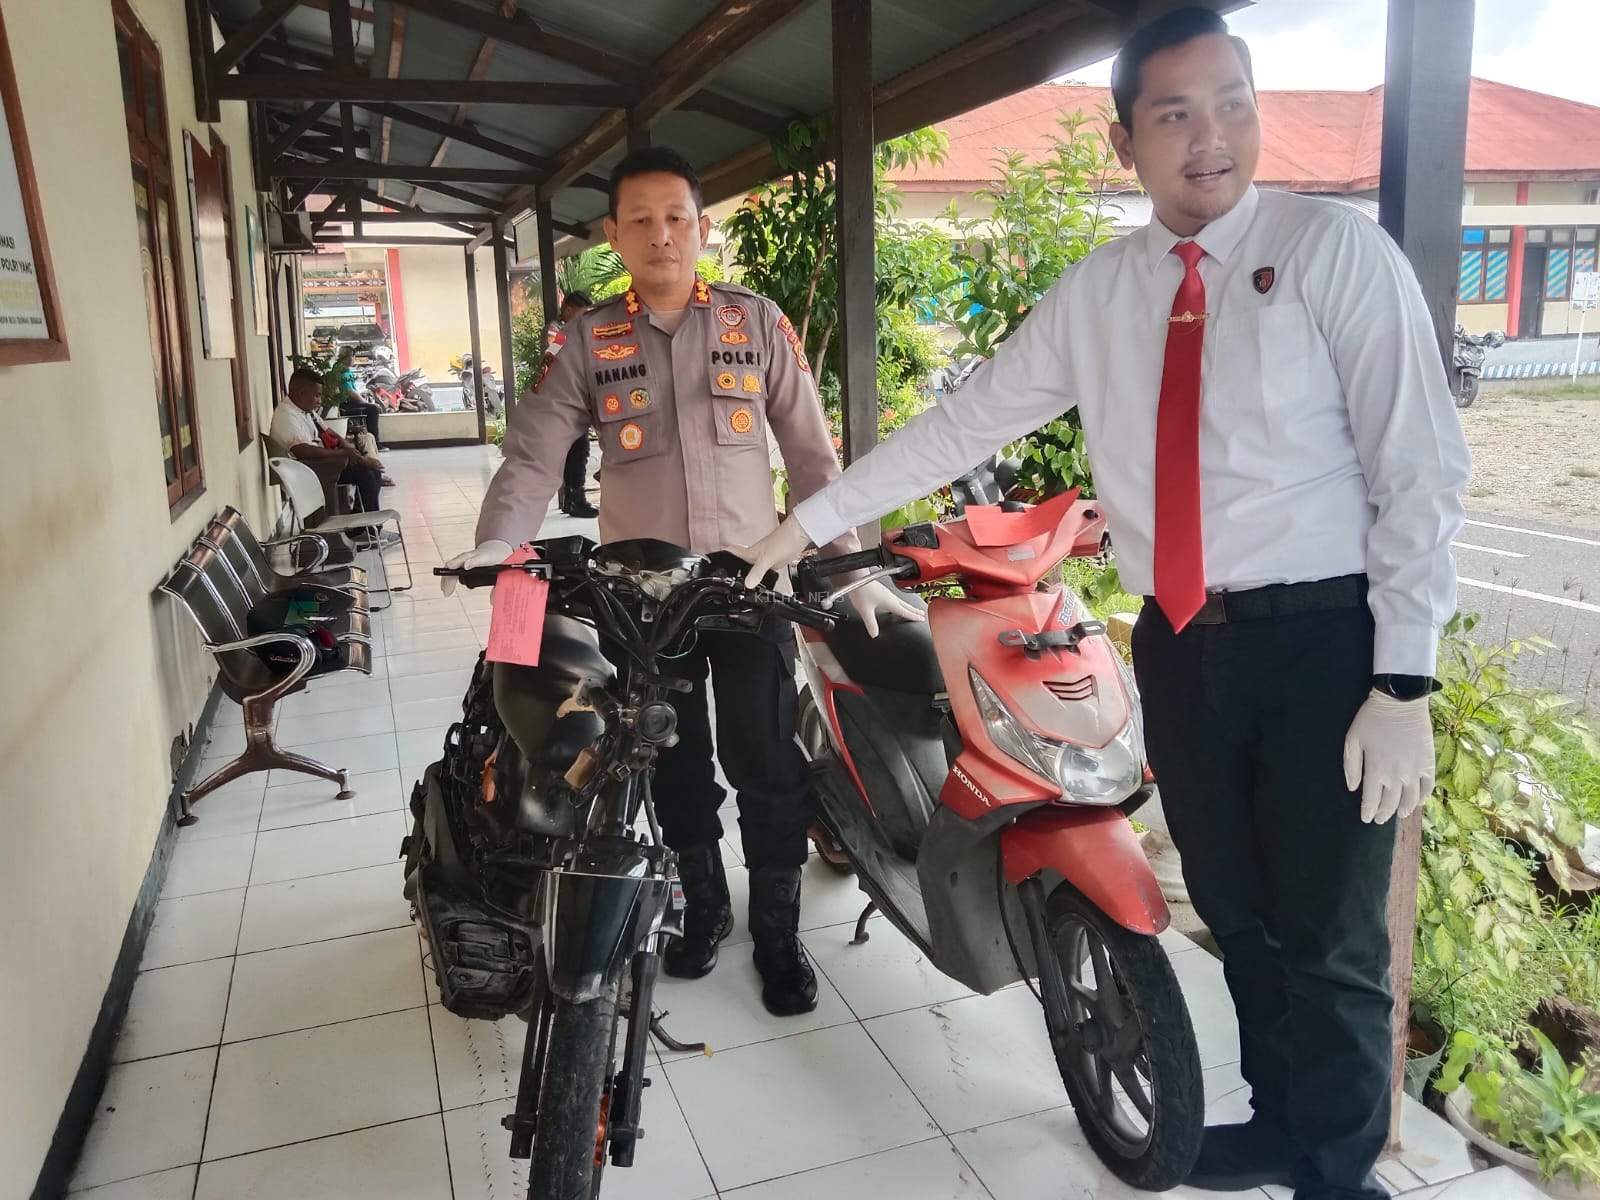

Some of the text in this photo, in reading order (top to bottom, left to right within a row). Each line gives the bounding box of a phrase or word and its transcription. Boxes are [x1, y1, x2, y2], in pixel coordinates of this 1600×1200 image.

[711, 350, 761, 366] POLRI
[595, 364, 647, 386] NANANG
[952, 764, 992, 808] HONDA
